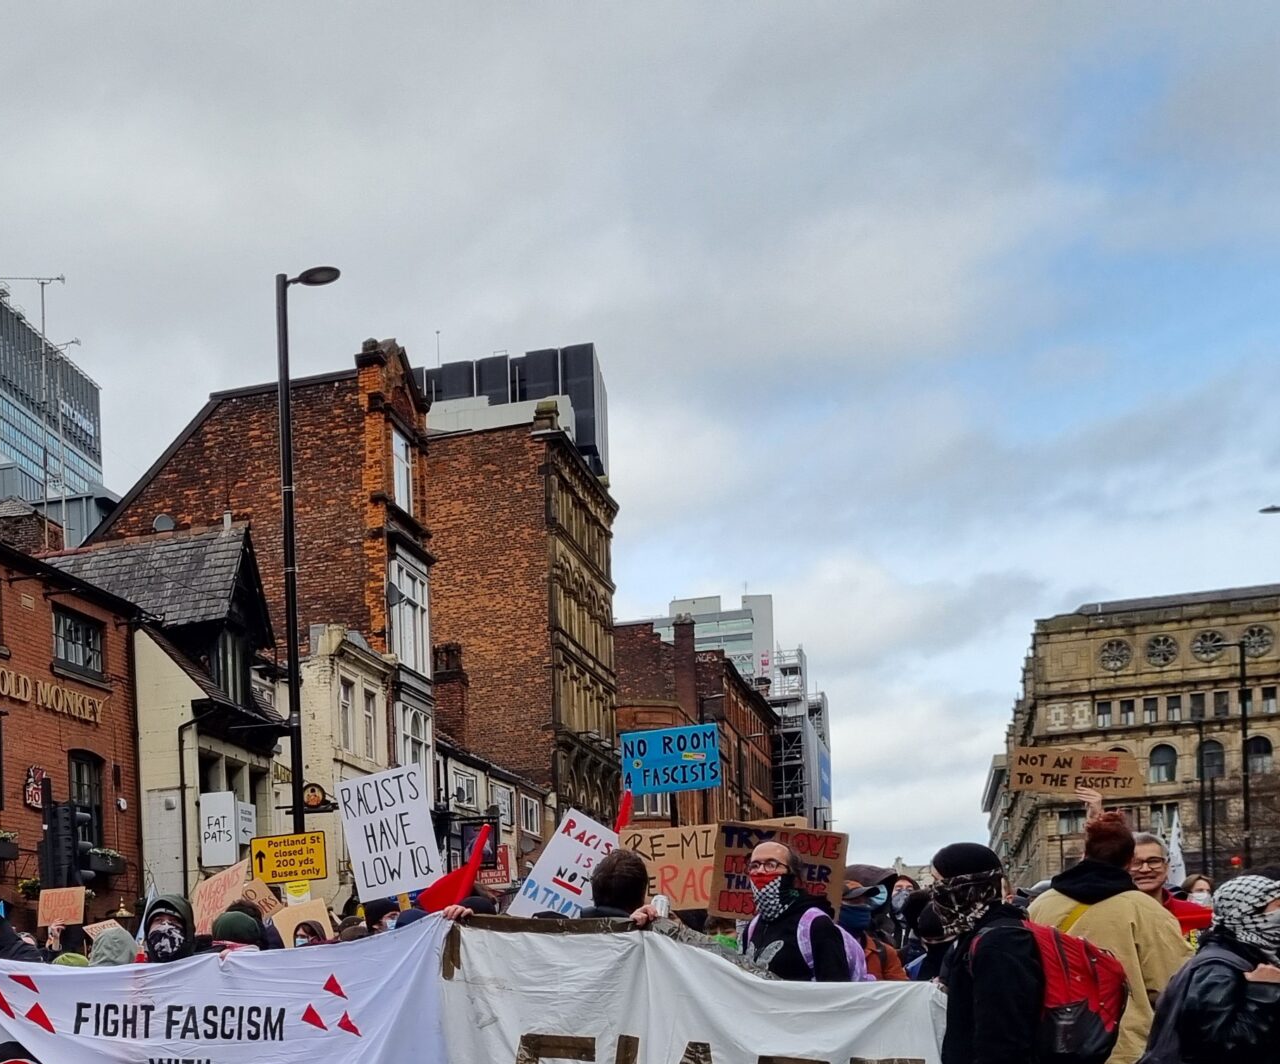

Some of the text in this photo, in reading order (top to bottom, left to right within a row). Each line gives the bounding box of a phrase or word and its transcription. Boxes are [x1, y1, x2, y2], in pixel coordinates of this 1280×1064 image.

[36, 680, 110, 724] MONKEY
[624, 730, 715, 759] NO ROOM
[1018, 754, 1048, 766] NOT
[1053, 757, 1073, 768] AN
[625, 761, 719, 788] 4 FASCISTS
[1016, 773, 1134, 789] TO THE FASCISTS!
[26, 787, 41, 804] HO
[340, 771, 419, 820] RACISTS
[207, 816, 227, 829] FAT
[363, 812, 415, 854] HAVE
[204, 830, 232, 843] PAT'S
[267, 836, 321, 848] Portland St
[562, 818, 614, 856] RACIS
[624, 829, 714, 861] RE-MI
[722, 826, 842, 859] TRY LOVE
[274, 848, 303, 858] closed
[276, 858, 314, 868] 200 yds
[575, 853, 593, 868] IS
[272, 867, 320, 878] Buses only
[362, 846, 434, 888] LOW IQ
[556, 866, 590, 888] NOT
[659, 864, 714, 905] RAC
[718, 890, 756, 915] INS
[73, 1002, 285, 1041] FIGHT FASCISM
